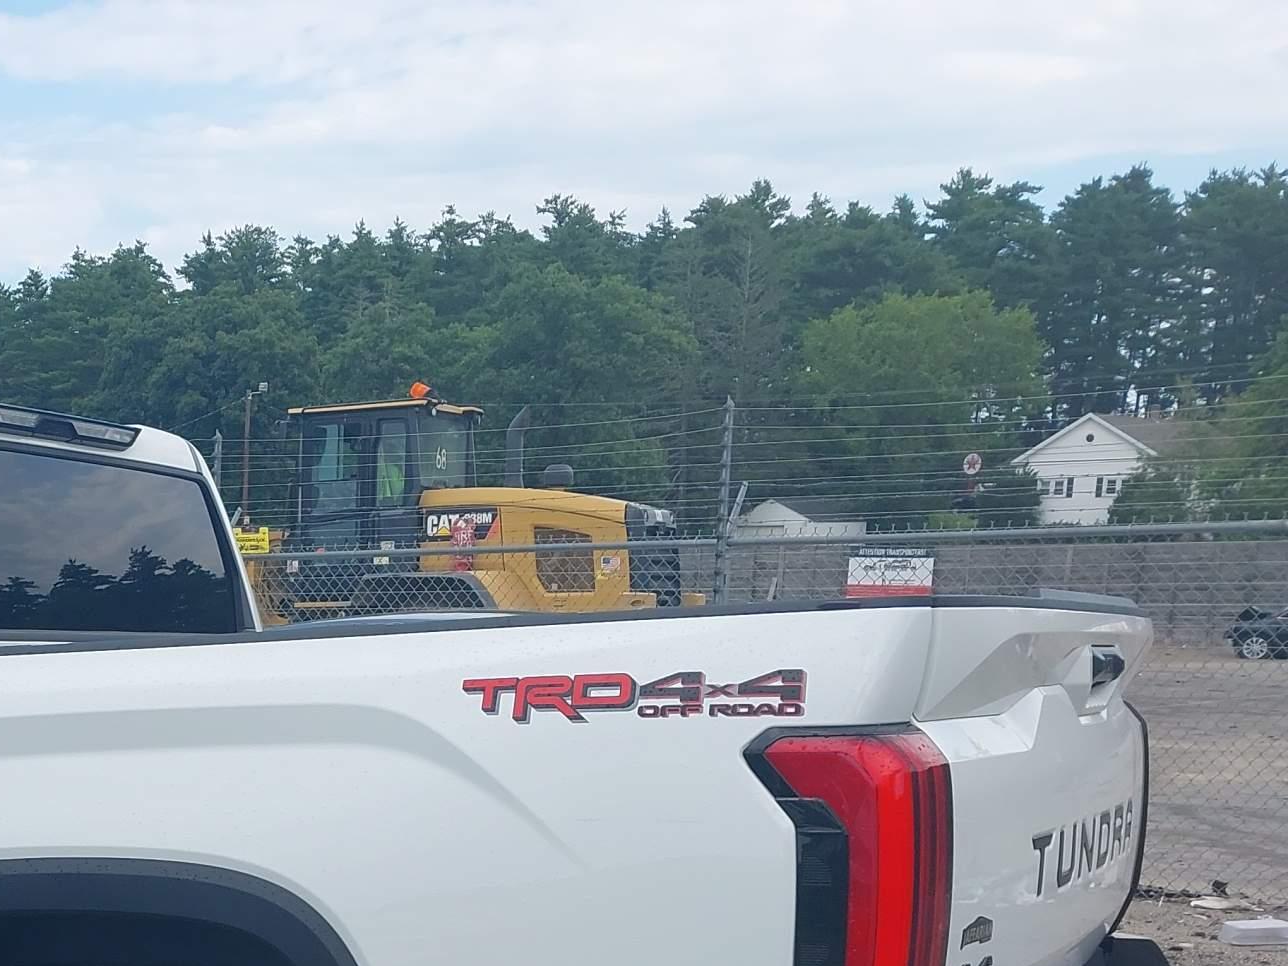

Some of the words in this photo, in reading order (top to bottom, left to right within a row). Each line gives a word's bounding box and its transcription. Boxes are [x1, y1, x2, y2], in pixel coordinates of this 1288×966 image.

[426, 513, 459, 537] CAT
[462, 672, 639, 725] TRD
[637, 703, 704, 719] OFF
[708, 702, 806, 718] ROAD
[1031, 798, 1133, 898] TUNDRA
